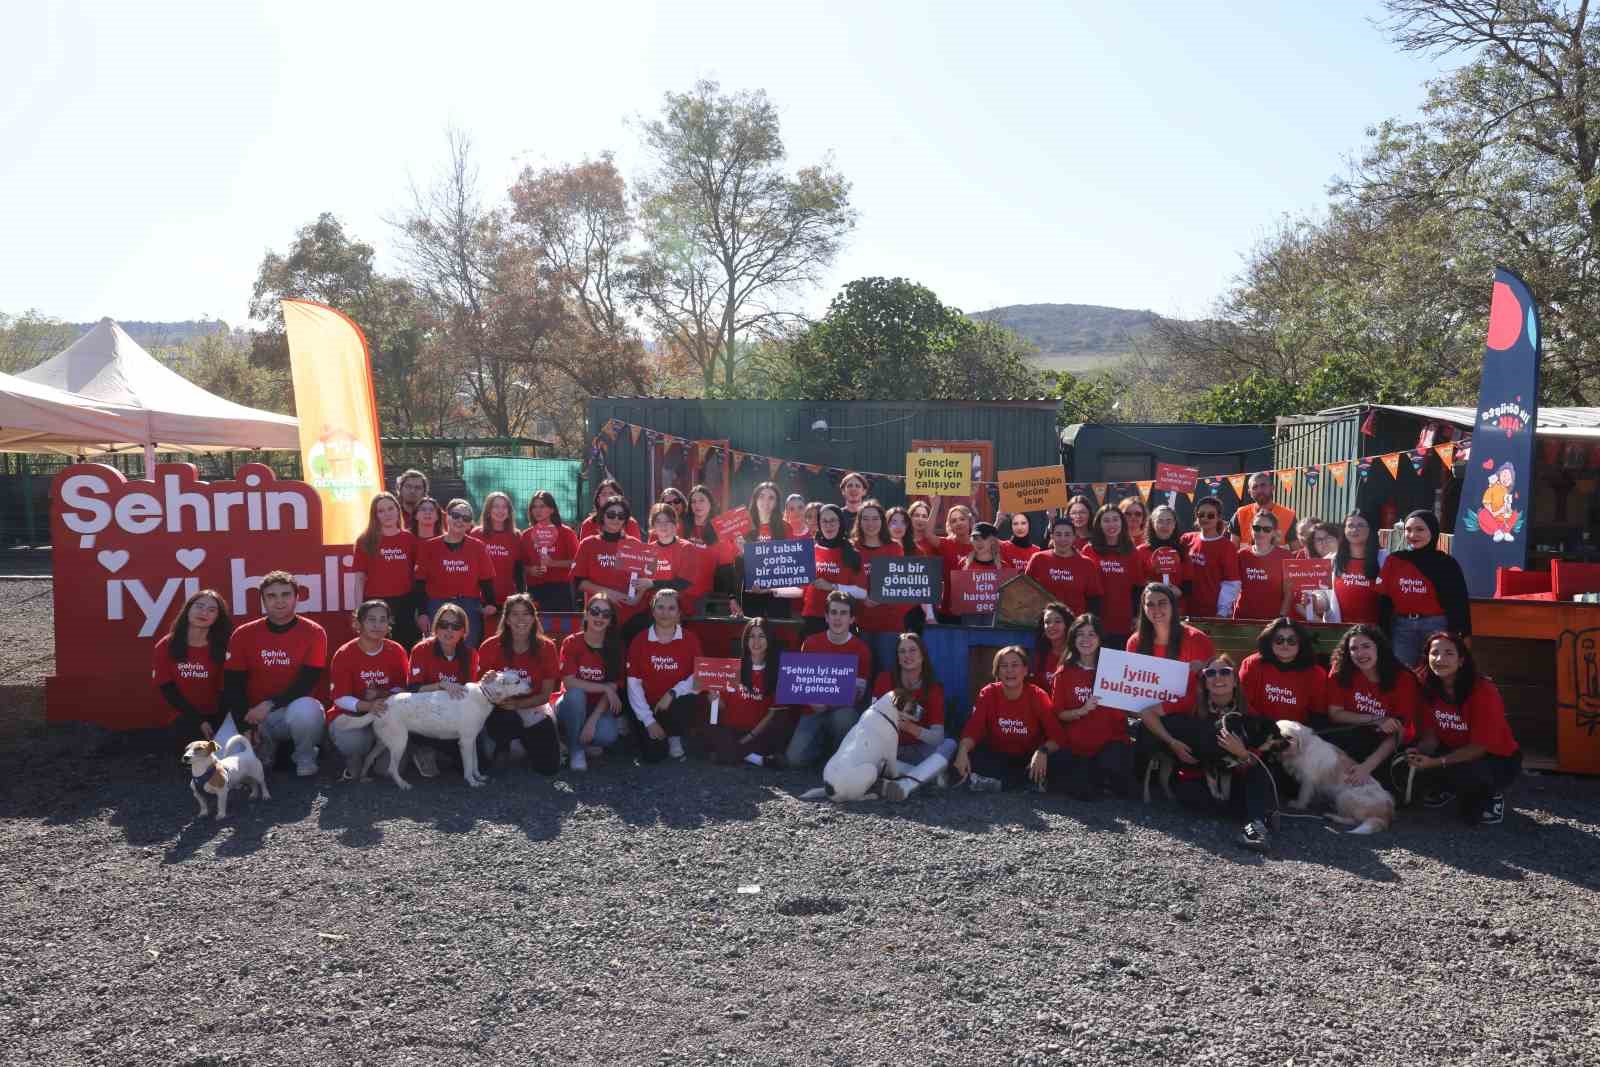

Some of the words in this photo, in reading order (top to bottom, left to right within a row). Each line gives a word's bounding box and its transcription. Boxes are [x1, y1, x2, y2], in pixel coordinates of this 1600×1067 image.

[918, 458, 960, 468] Gençler
[914, 468, 941, 479] iyilik
[943, 468, 963, 479] için
[915, 480, 961, 491] çalışıyor
[61, 474, 309, 549] Şehrin
[755, 546, 770, 555] Bir
[773, 543, 803, 553] tabak
[763, 555, 796, 566] çorba,
[755, 567, 770, 576] bir
[773, 565, 805, 577] dünya
[888, 562, 905, 573] Bu
[907, 562, 925, 573] bir
[753, 576, 809, 588] dayanışma
[884, 575, 929, 586] gönüllü
[97, 548, 206, 637] iyi
[881, 586, 931, 597] hareketi
[976, 582, 994, 592] için
[1123, 664, 1161, 685] İyilik
[795, 676, 838, 686] hepimize
[804, 684, 841, 694] gelecek
